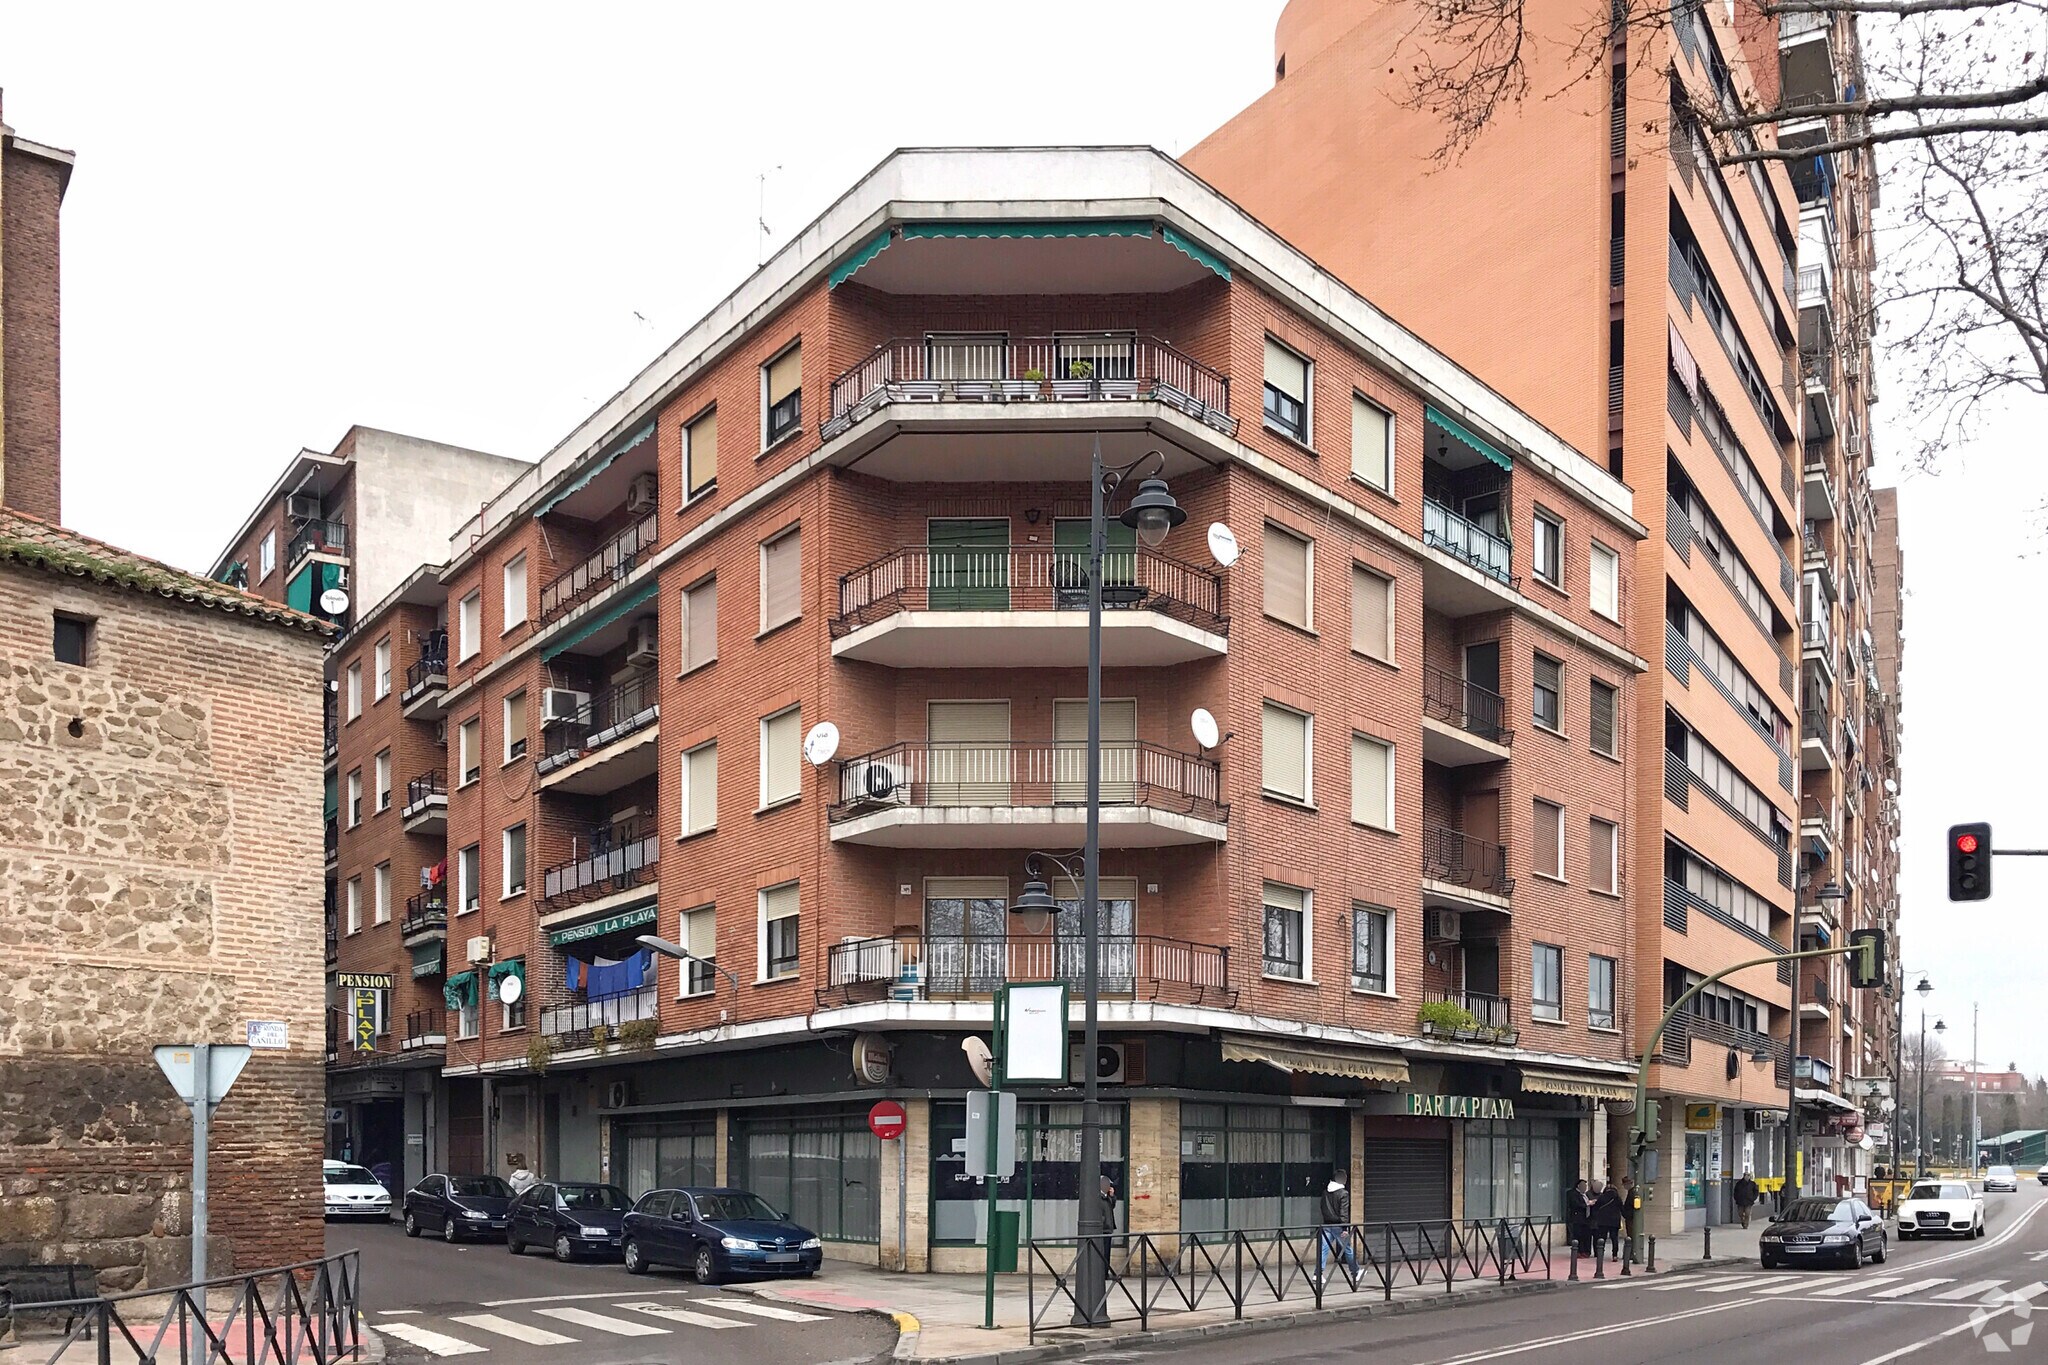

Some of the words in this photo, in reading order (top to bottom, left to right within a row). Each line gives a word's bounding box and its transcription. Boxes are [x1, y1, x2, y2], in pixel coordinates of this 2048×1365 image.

[561, 924, 600, 942] PENSION
[604, 920, 619, 932] LA
[622, 908, 656, 927] PLAYA
[338, 974, 391, 988] PENSION
[357, 990, 374, 998] LA
[356, 998, 375, 1051] PLAYA
[1332, 1063, 1343, 1071] LA
[1348, 1065, 1376, 1075] PLAYA
[1413, 1094, 1442, 1116] BAR
[1449, 1096, 1467, 1118] LA
[1472, 1097, 1515, 1119] PLAYA
